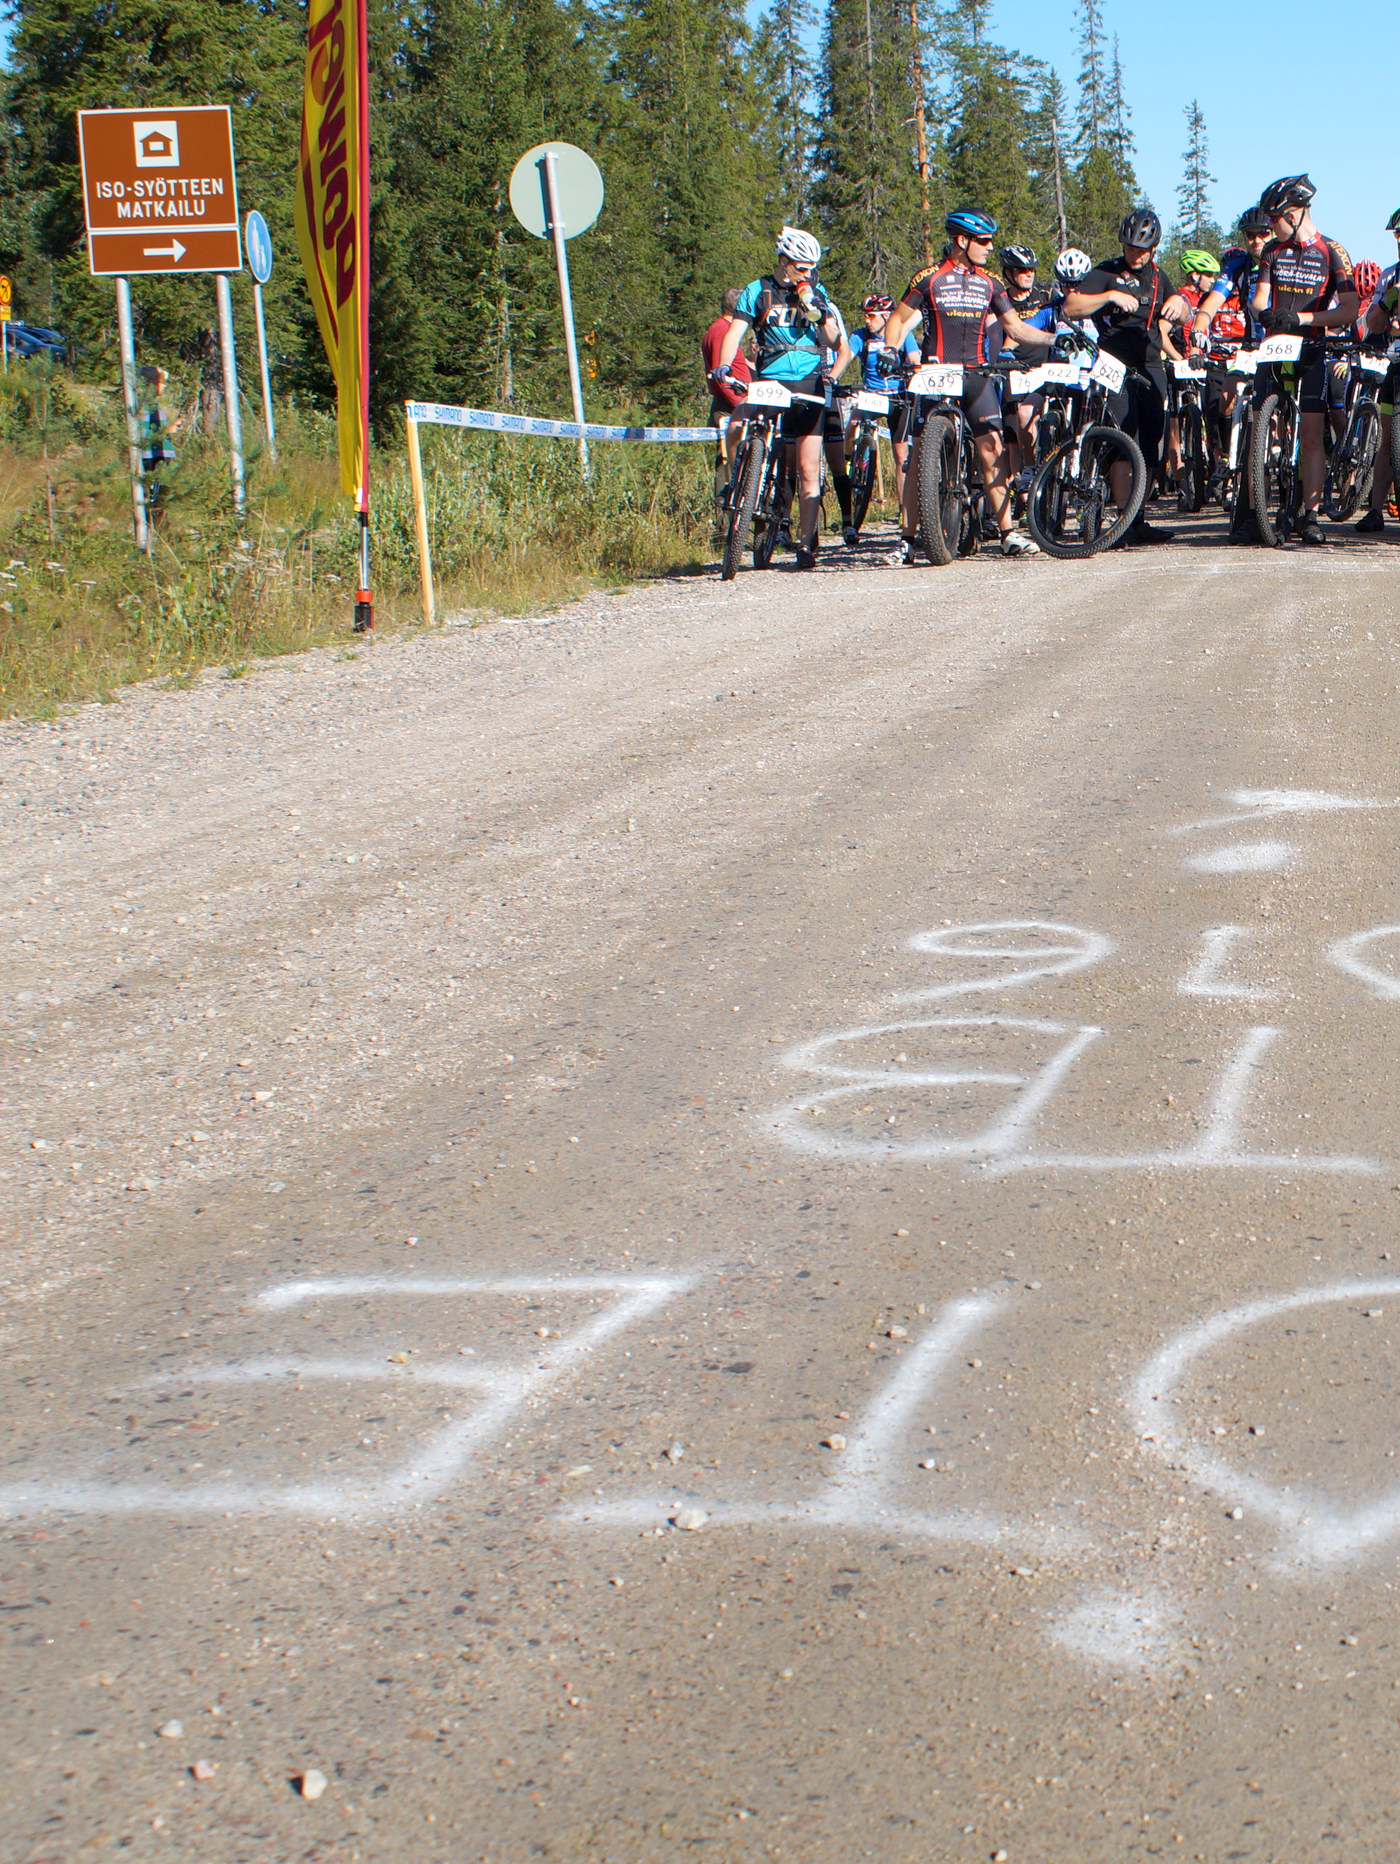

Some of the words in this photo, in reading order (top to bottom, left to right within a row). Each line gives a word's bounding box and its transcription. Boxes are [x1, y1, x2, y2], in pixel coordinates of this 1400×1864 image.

[96, 177, 224, 199] ISO-SYÖTTEEN
[117, 199, 206, 219] MATKAILU
[1266, 344, 1293, 355] 568
[928, 375, 955, 388] 639
[1047, 369, 1072, 378] 622
[1099, 364, 1121, 383] 620
[756, 387, 784, 399] 699
[434, 406, 462, 422] SHIMANO
[469, 411, 495, 426] SHIMANO
[501, 415, 526, 430] SHIMANO
